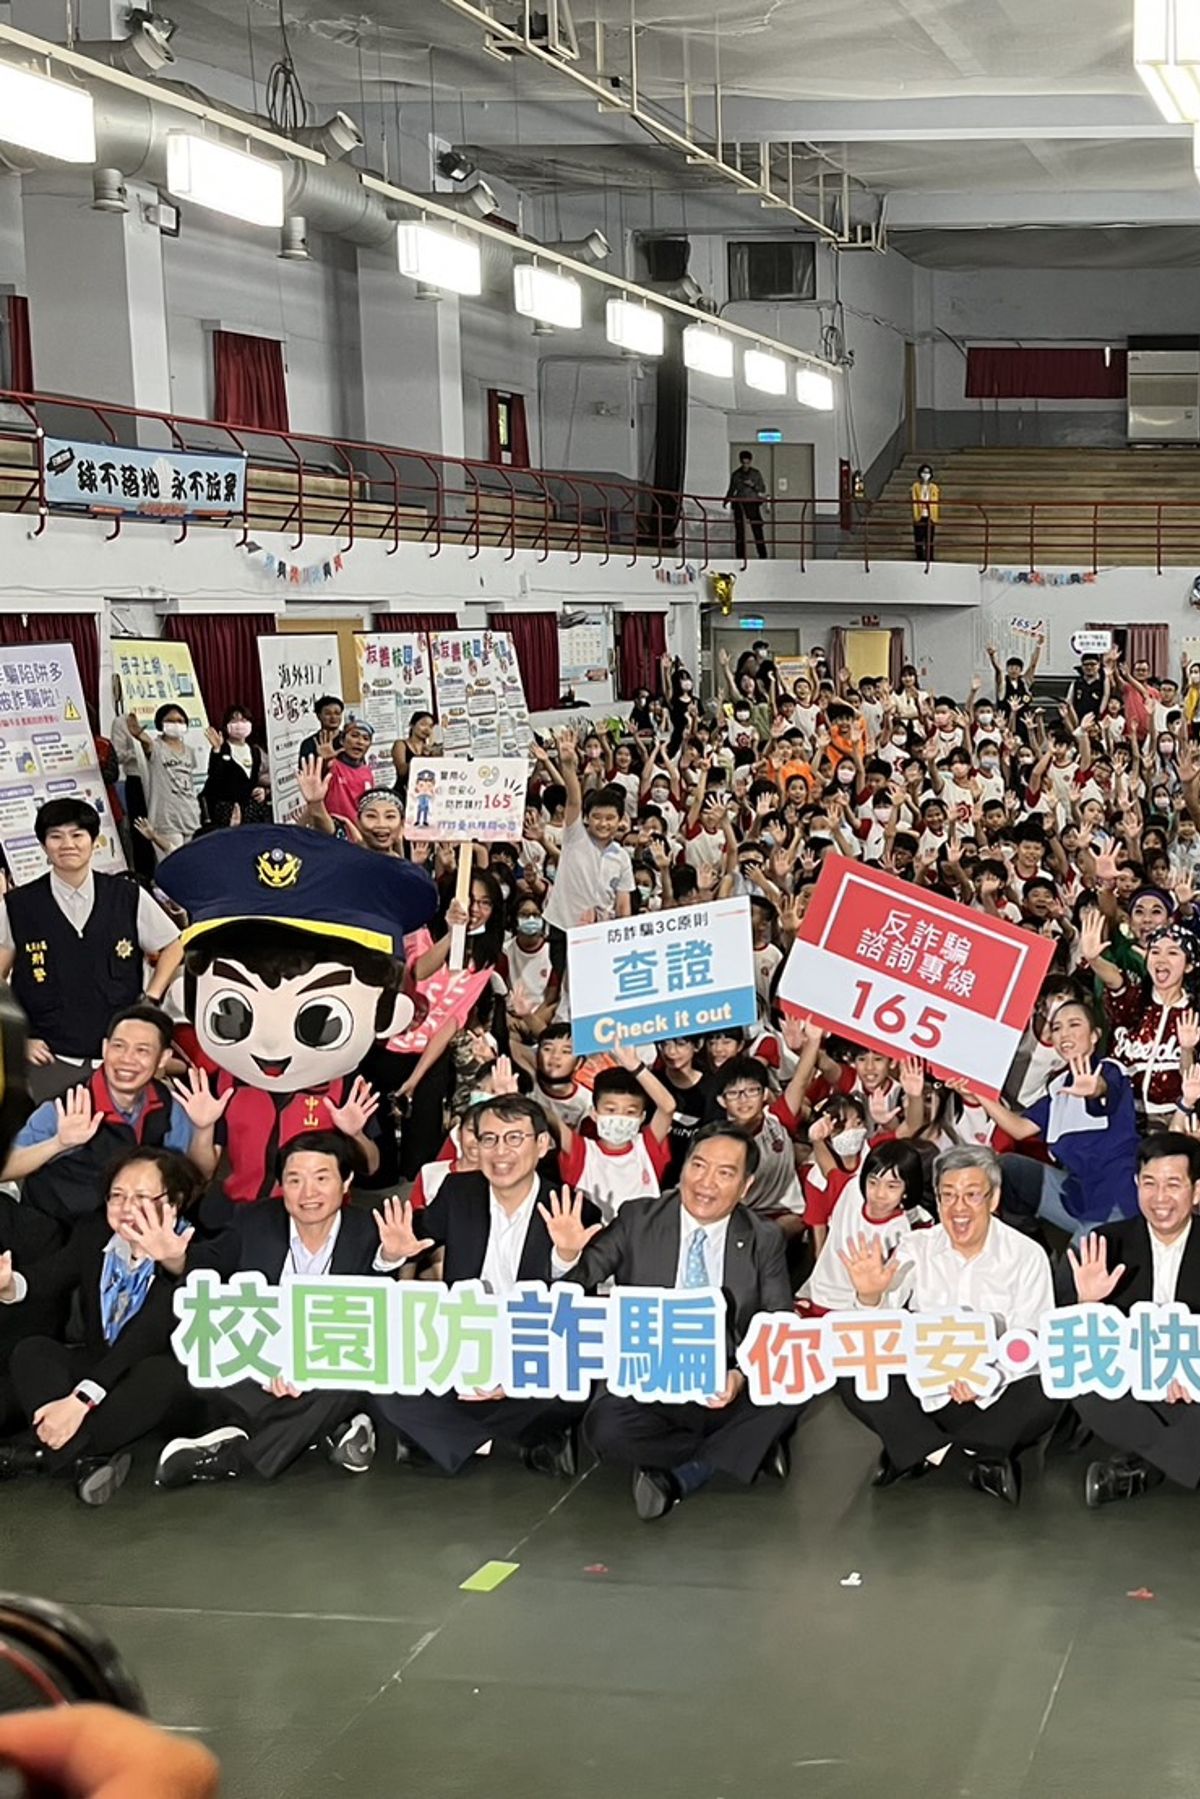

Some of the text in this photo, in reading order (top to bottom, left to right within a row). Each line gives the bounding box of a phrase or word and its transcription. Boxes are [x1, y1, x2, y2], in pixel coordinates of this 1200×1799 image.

[77, 460, 160, 498] 球不落地
[171, 469, 238, 502] 永不放棄
[607, 911, 708, 944] 防詐騙3C原則
[880, 908, 973, 966] 反詐騙
[612, 938, 714, 1001] 查證
[855, 927, 977, 999] 諮詢專線
[593, 1002, 733, 1045] Check it out
[851, 978, 948, 1049] 165
[303, 1095, 319, 1127] 中山
[180, 1278, 717, 1396] 校園防詐騙
